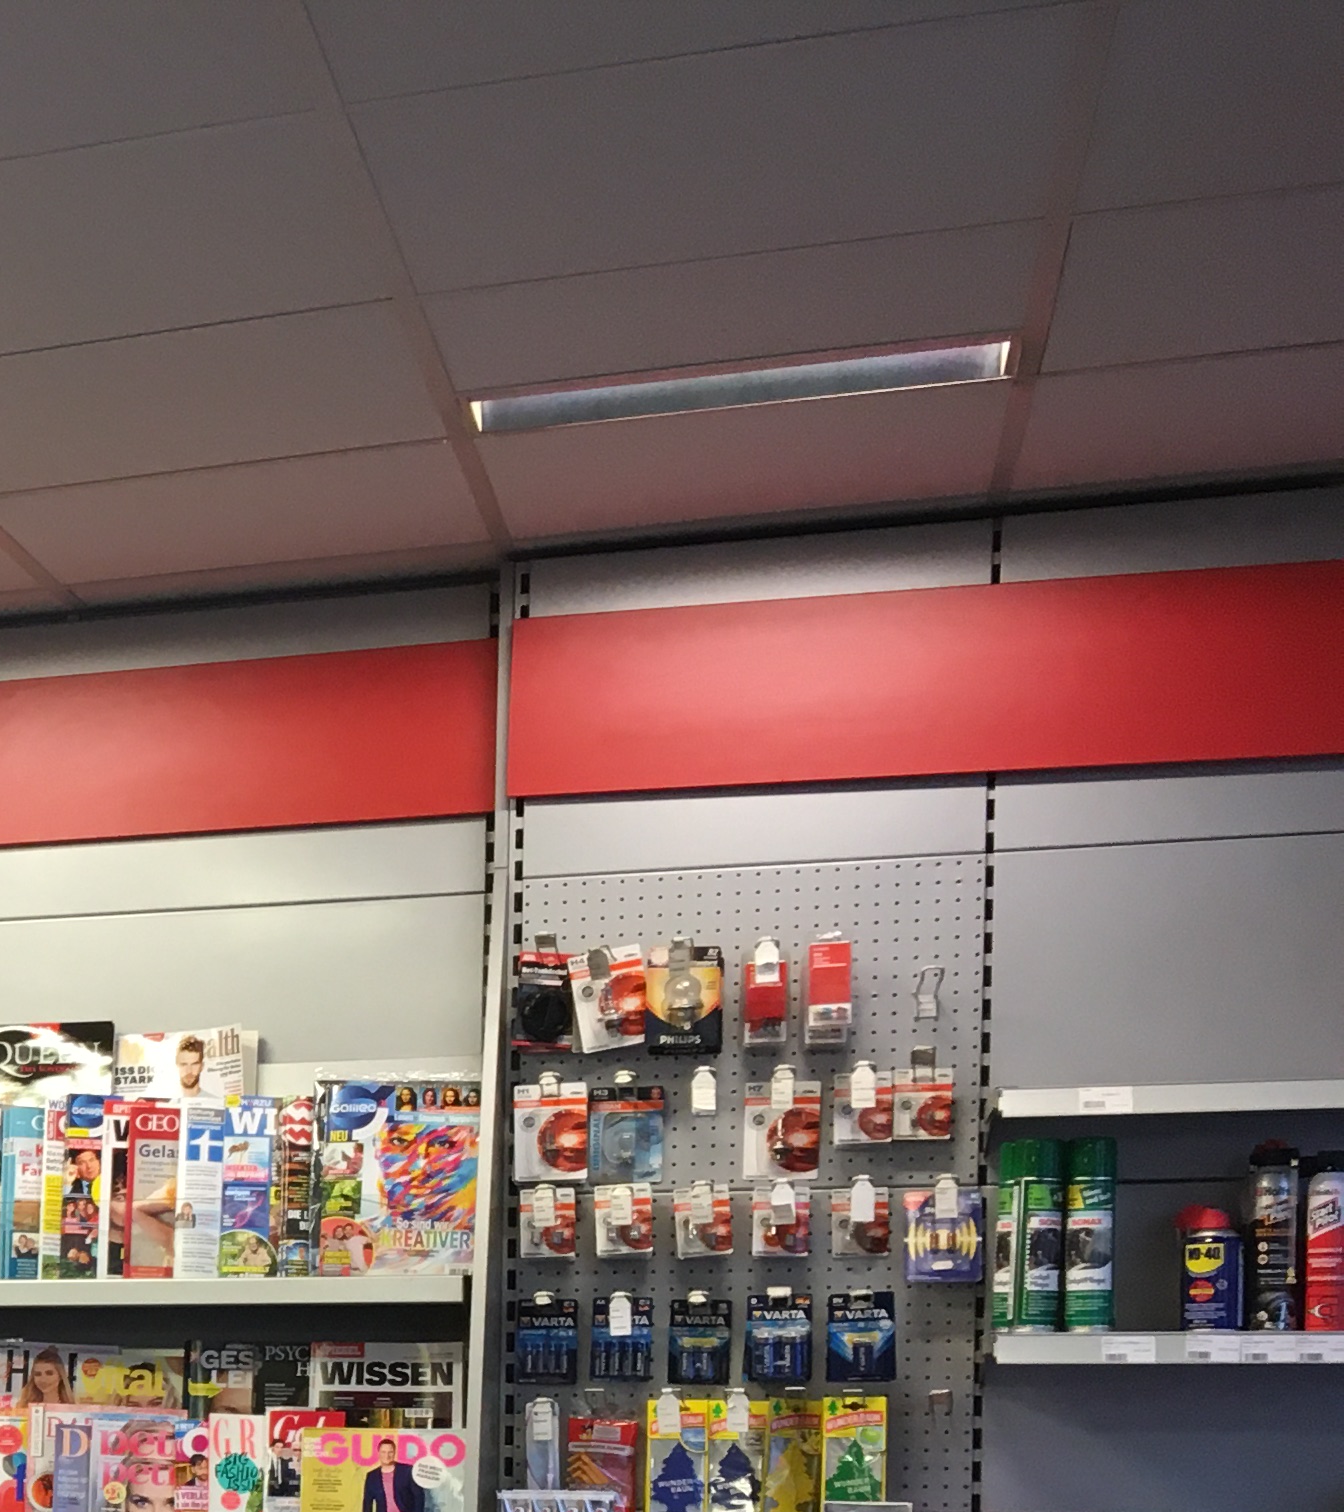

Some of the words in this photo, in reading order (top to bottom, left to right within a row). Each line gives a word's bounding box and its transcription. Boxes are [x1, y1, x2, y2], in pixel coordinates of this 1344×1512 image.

[660, 1034, 701, 1046] PHILIPS
[114, 1075, 154, 1085] STARK
[748, 1083, 765, 1094] H7
[329, 1103, 377, 1113] Galileo
[134, 1114, 179, 1132] GEO
[329, 1131, 349, 1142] NEU
[592, 1116, 602, 1171] ORIGINAL
[379, 1229, 471, 1250] KREATIVER
[1188, 1247, 1220, 1261] WD-40
[685, 1314, 726, 1326] VARTA
[764, 1310, 806, 1321] VARTA
[845, 1309, 888, 1321] VARTA
[532, 1316, 575, 1328] VARTA
[322, 1360, 454, 1387] WISSEN
[318, 1432, 466, 1466] GUIDO
